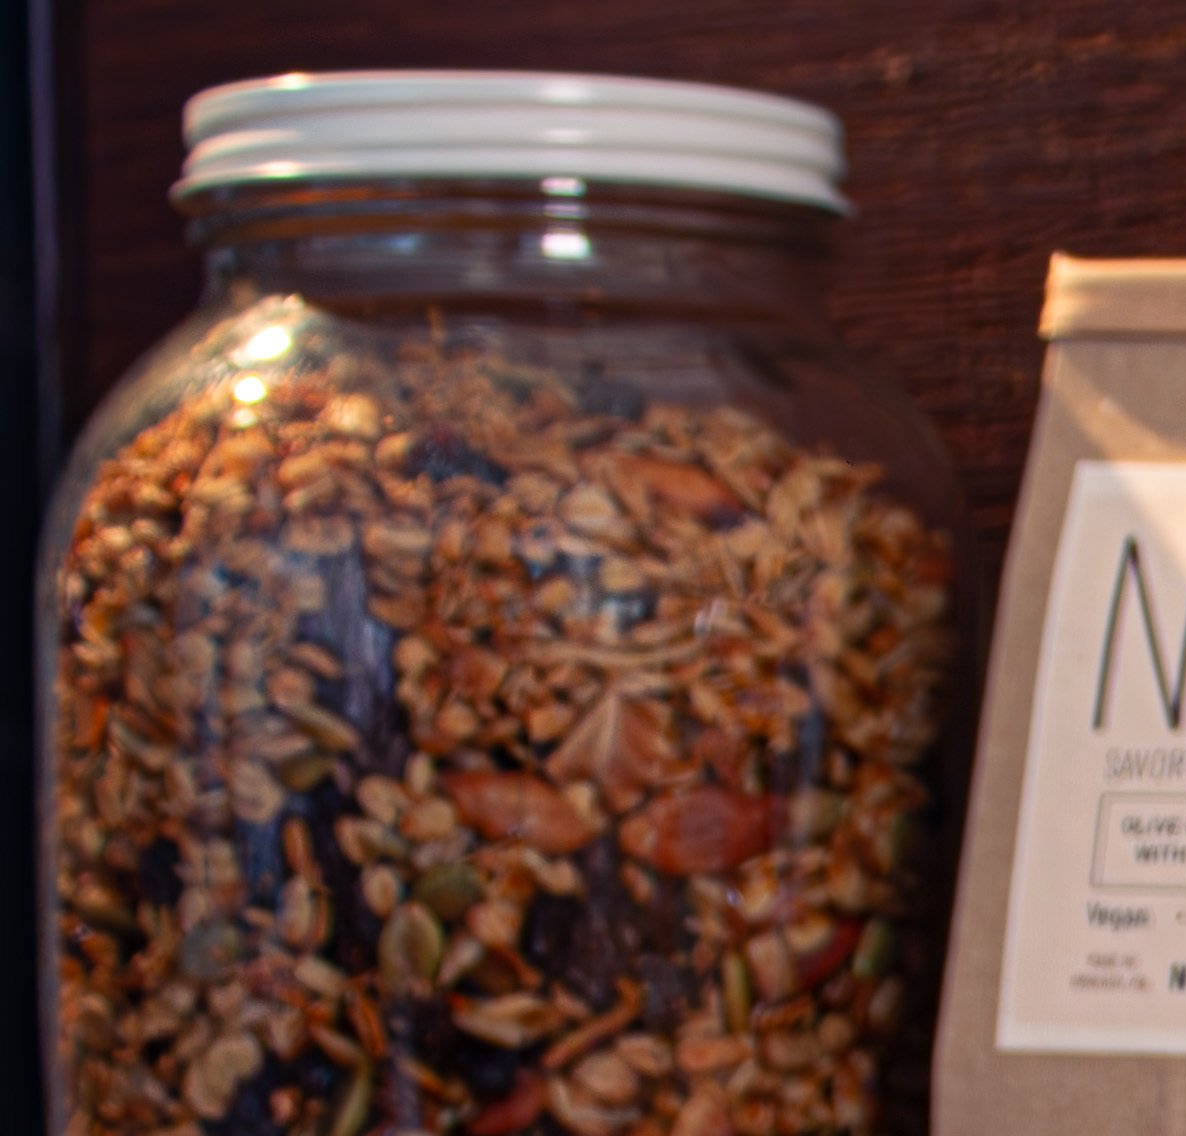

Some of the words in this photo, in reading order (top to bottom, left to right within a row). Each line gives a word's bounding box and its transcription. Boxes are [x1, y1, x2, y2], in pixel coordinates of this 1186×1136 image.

[1121, 816, 1181, 838] OLIVE
[1135, 844, 1186, 866] WITH
[1086, 902, 1150, 930] Vegan
